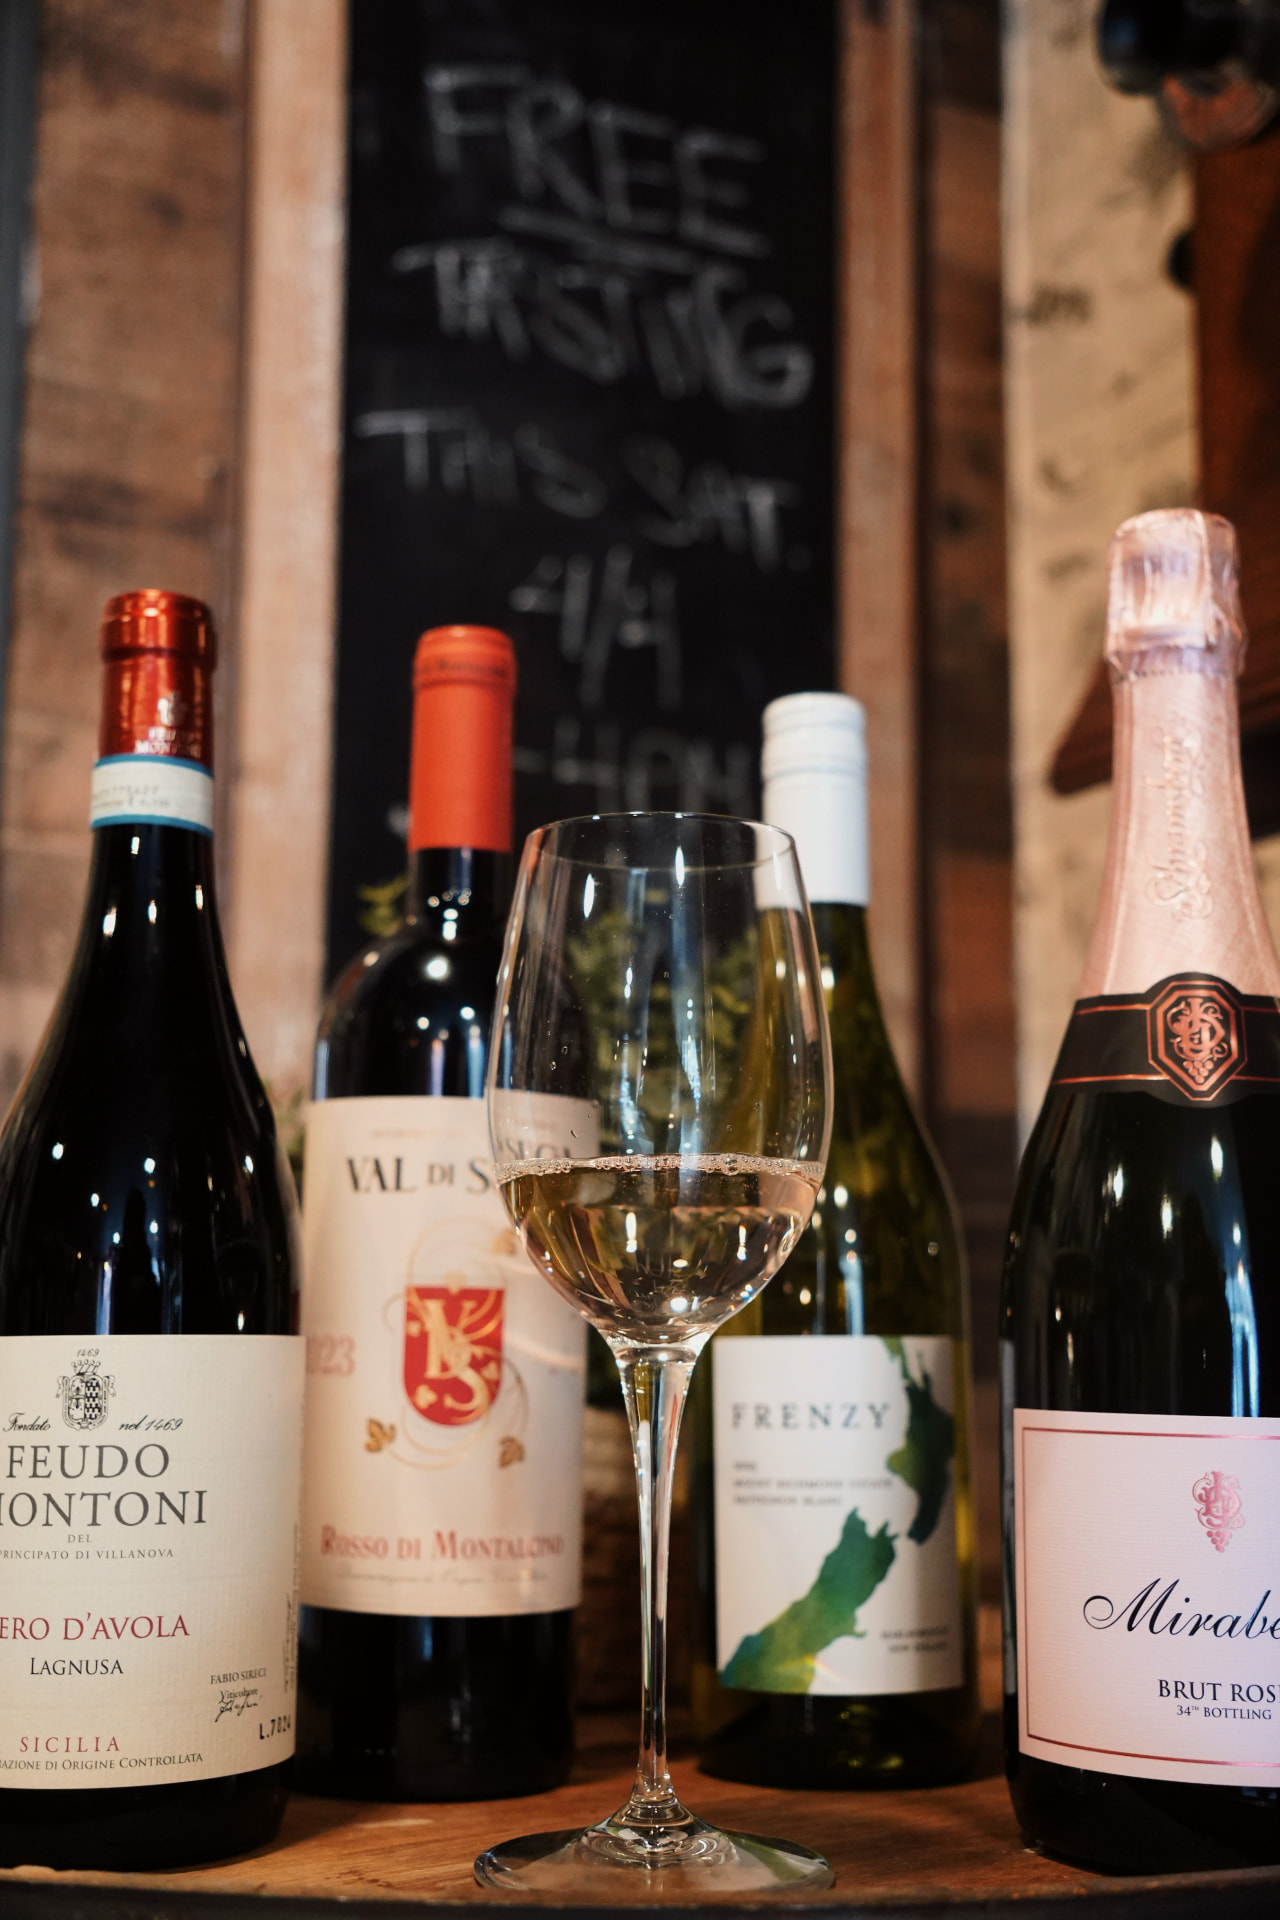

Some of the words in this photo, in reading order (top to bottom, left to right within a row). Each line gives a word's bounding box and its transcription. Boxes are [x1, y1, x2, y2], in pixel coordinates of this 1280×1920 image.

[423, 64, 768, 258] FREE
[392, 236, 814, 410] TASTING
[346, 1156, 416, 1193] VAL
[427, 1163, 455, 1185] DI
[2, 1412, 51, 1432] Fondato
[118, 1415, 148, 1431] nel
[144, 1418, 184, 1431] 1469
[731, 1402, 891, 1430] FRENZY
[5, 1443, 170, 1479] FEUDO
[0, 1490, 208, 1527] ONTONI
[67, 1534, 93, 1544] DEL
[321, 1525, 389, 1560] ROSSO
[397, 1538, 422, 1559] DI
[75, 1550, 90, 1560] DI
[96, 1548, 174, 1560] VILLANOVA
[63, 1612, 190, 1640] D'AVOLA
[30, 1657, 124, 1675] LAGNUSA
[210, 1673, 240, 1684] FABIO
[1158, 1679, 1222, 1701] BRUT
[1230, 1683, 1280, 1703] ROS
[1203, 1706, 1272, 1719] BOTTLING
[19, 1736, 120, 1753] SICILIA
[0, 1759, 40, 1770] AZIONE
[45, 1760, 57, 1770] DI
[62, 1759, 115, 1770] ORIGINE
[119, 1753, 203, 1768] CONTROLLATA
